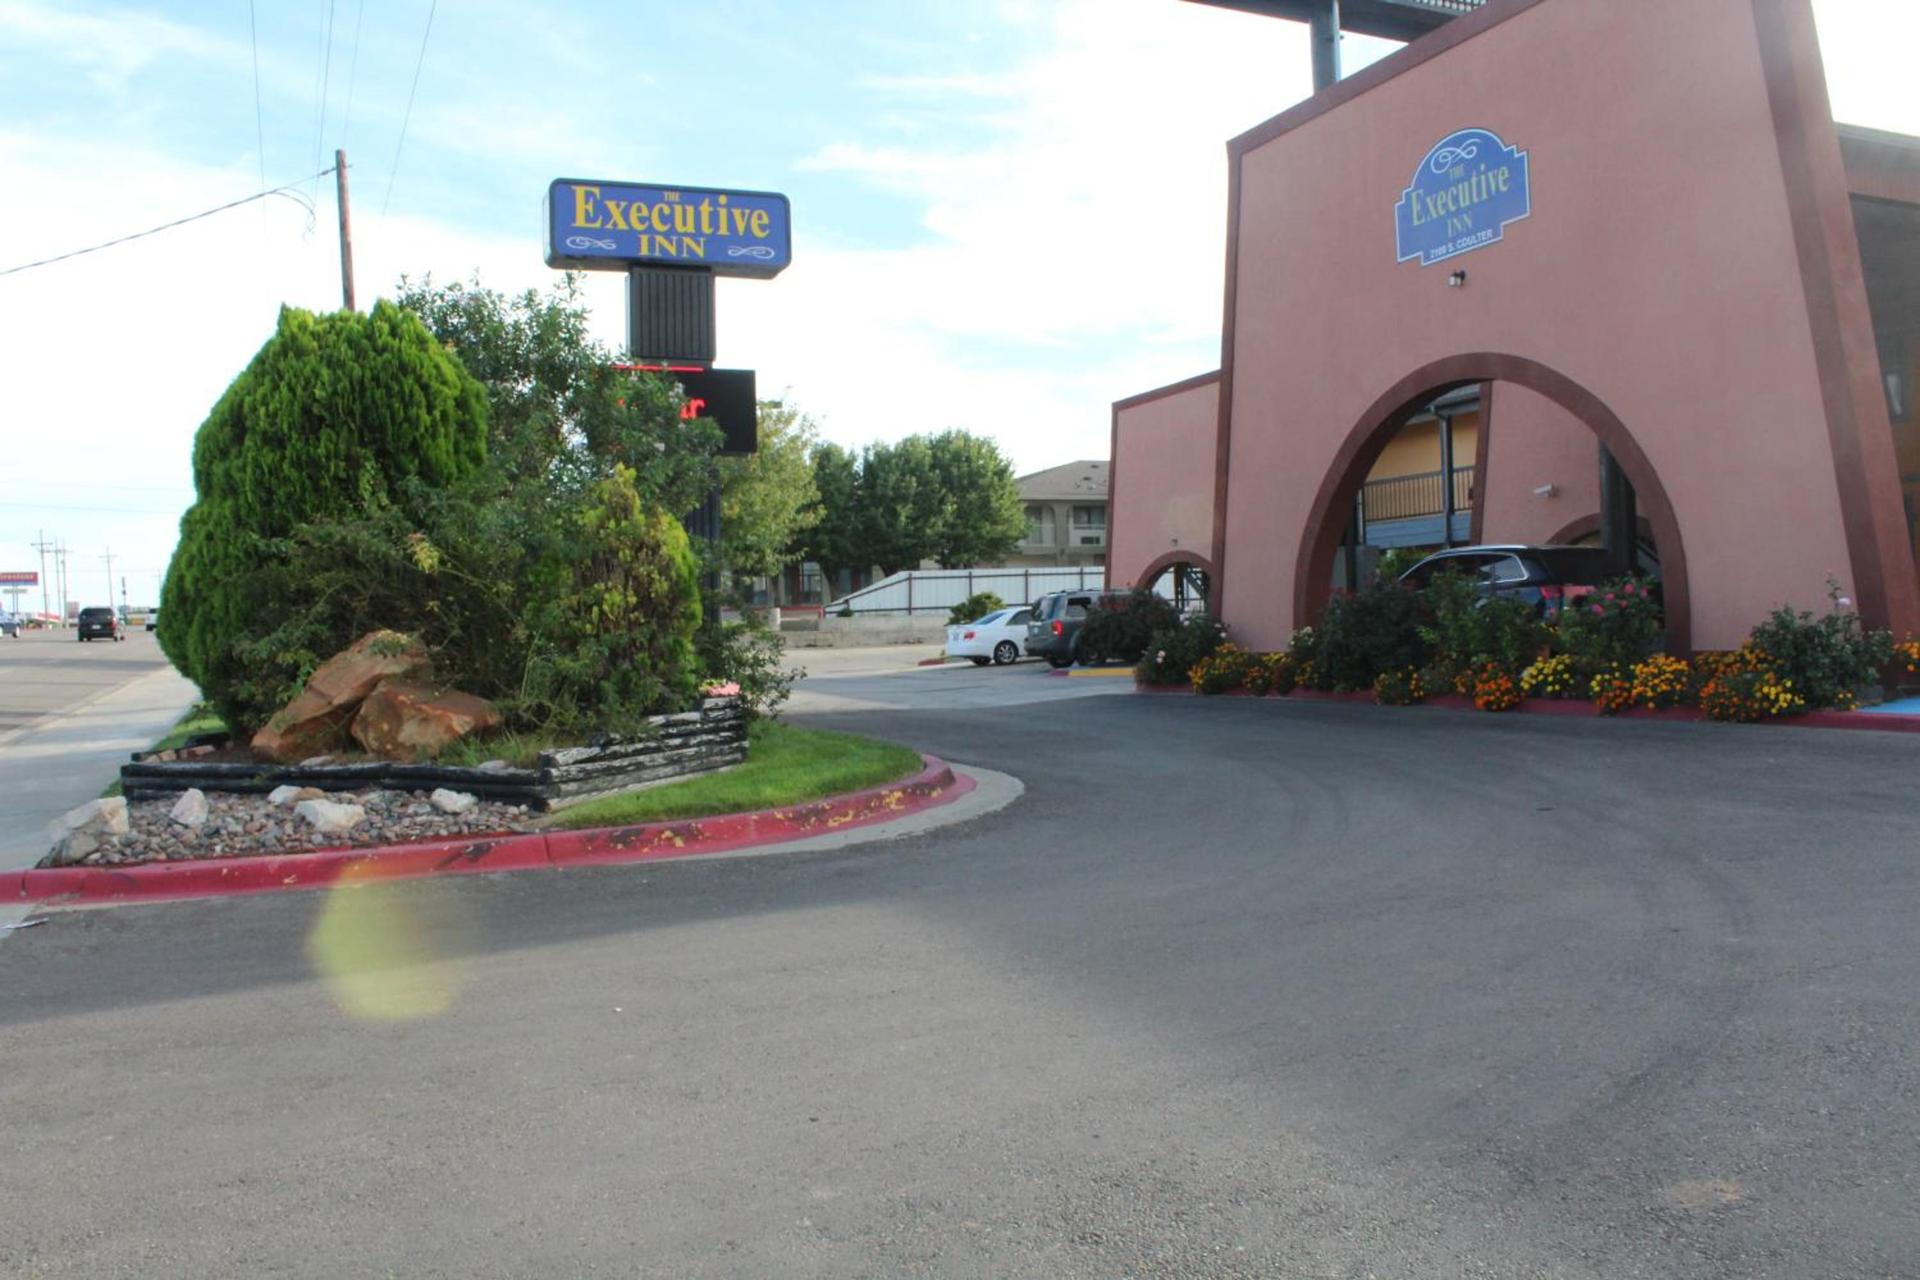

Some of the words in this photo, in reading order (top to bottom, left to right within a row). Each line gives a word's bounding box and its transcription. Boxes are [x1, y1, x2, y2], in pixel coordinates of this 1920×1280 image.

[664, 191, 680, 202] THE
[1410, 163, 1510, 227] Executive
[571, 185, 769, 238] Executive
[1447, 211, 1473, 238] INN
[638, 234, 706, 258] INN
[1456, 229, 1493, 249] COULTER
